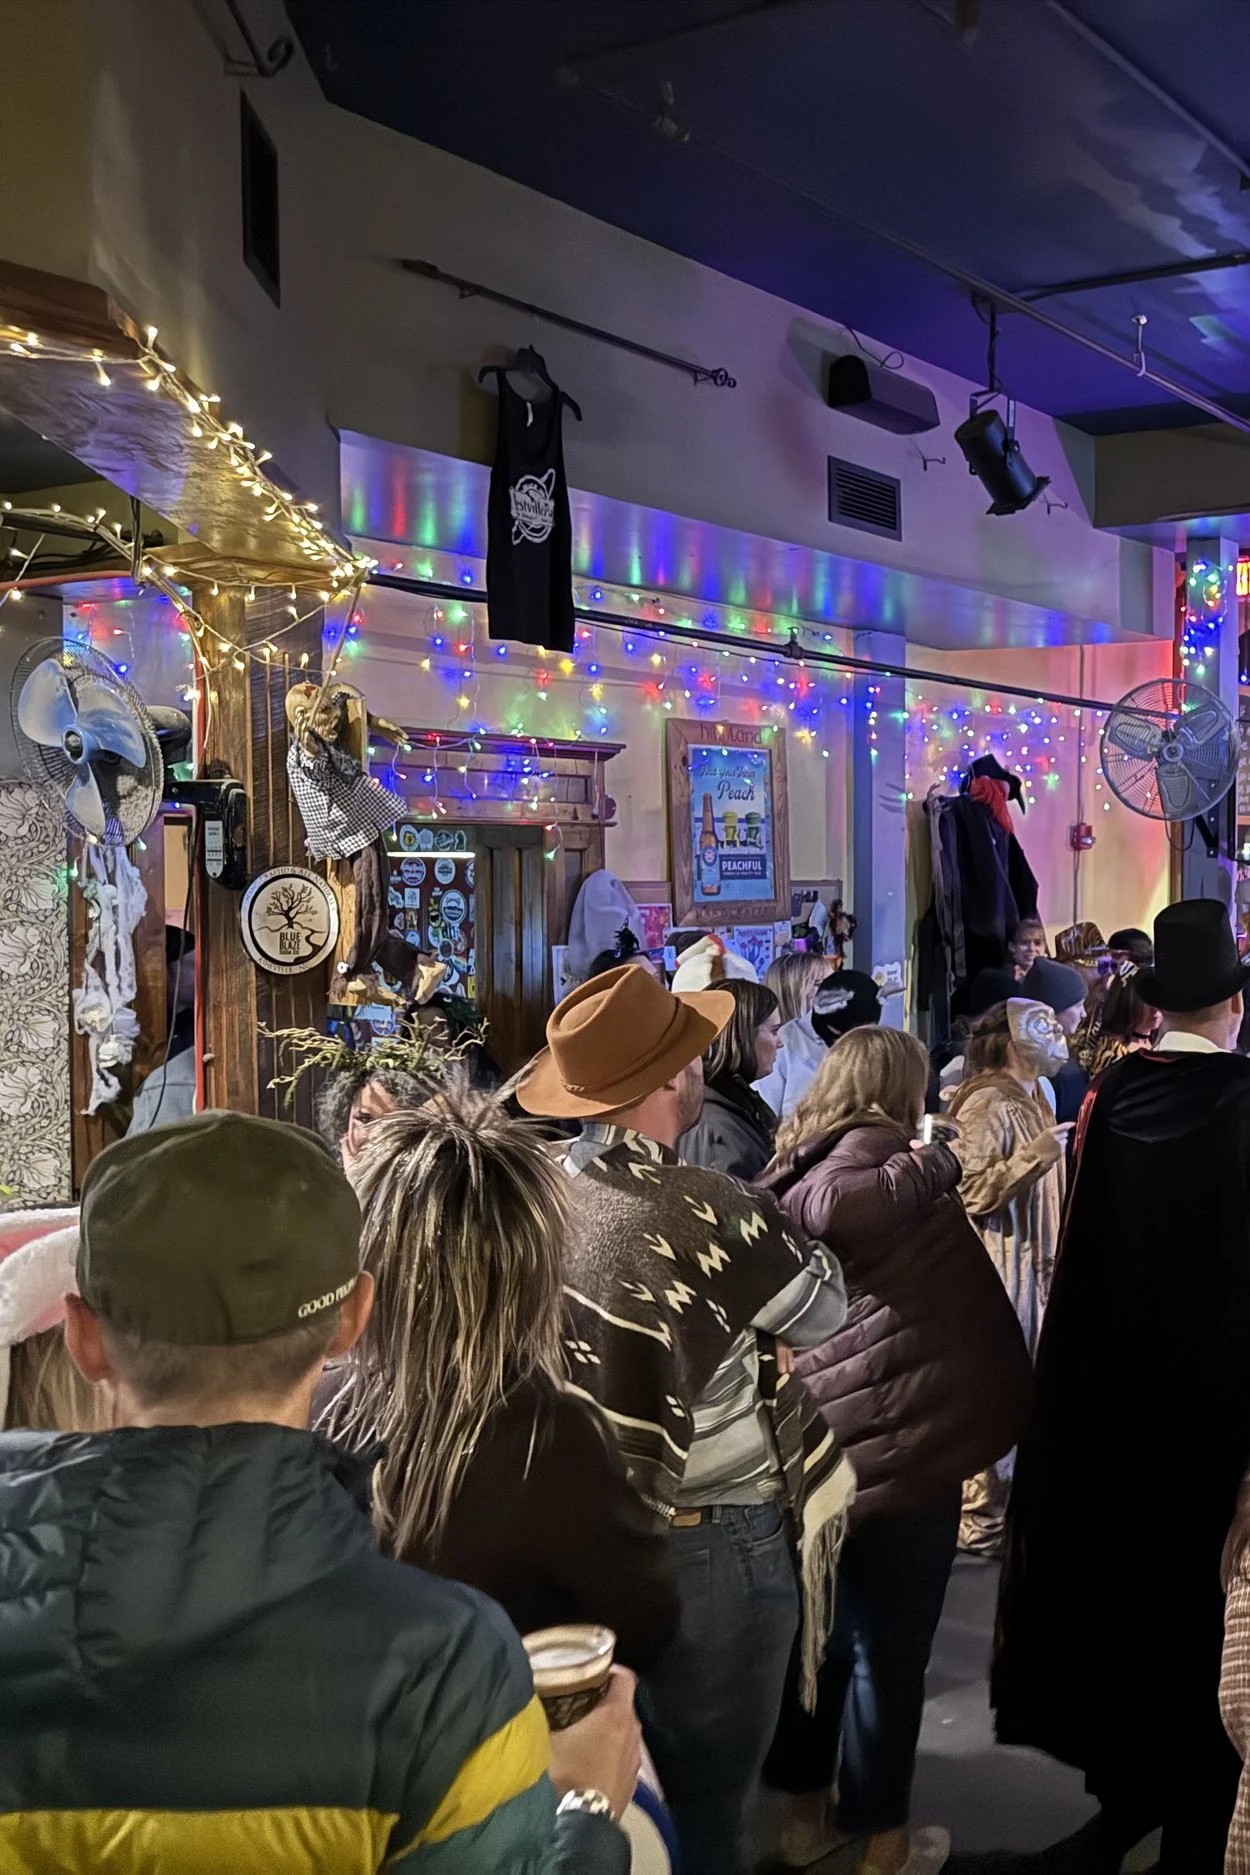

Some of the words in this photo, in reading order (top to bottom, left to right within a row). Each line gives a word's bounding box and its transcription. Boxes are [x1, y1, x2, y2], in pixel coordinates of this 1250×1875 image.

[717, 780, 756, 801] Peach
[721, 860, 763, 872] PEACHFUL
[279, 931, 301, 941] BLUE
[279, 940, 301, 950] BLAZE
[298, 1292, 335, 1318] GOOD
